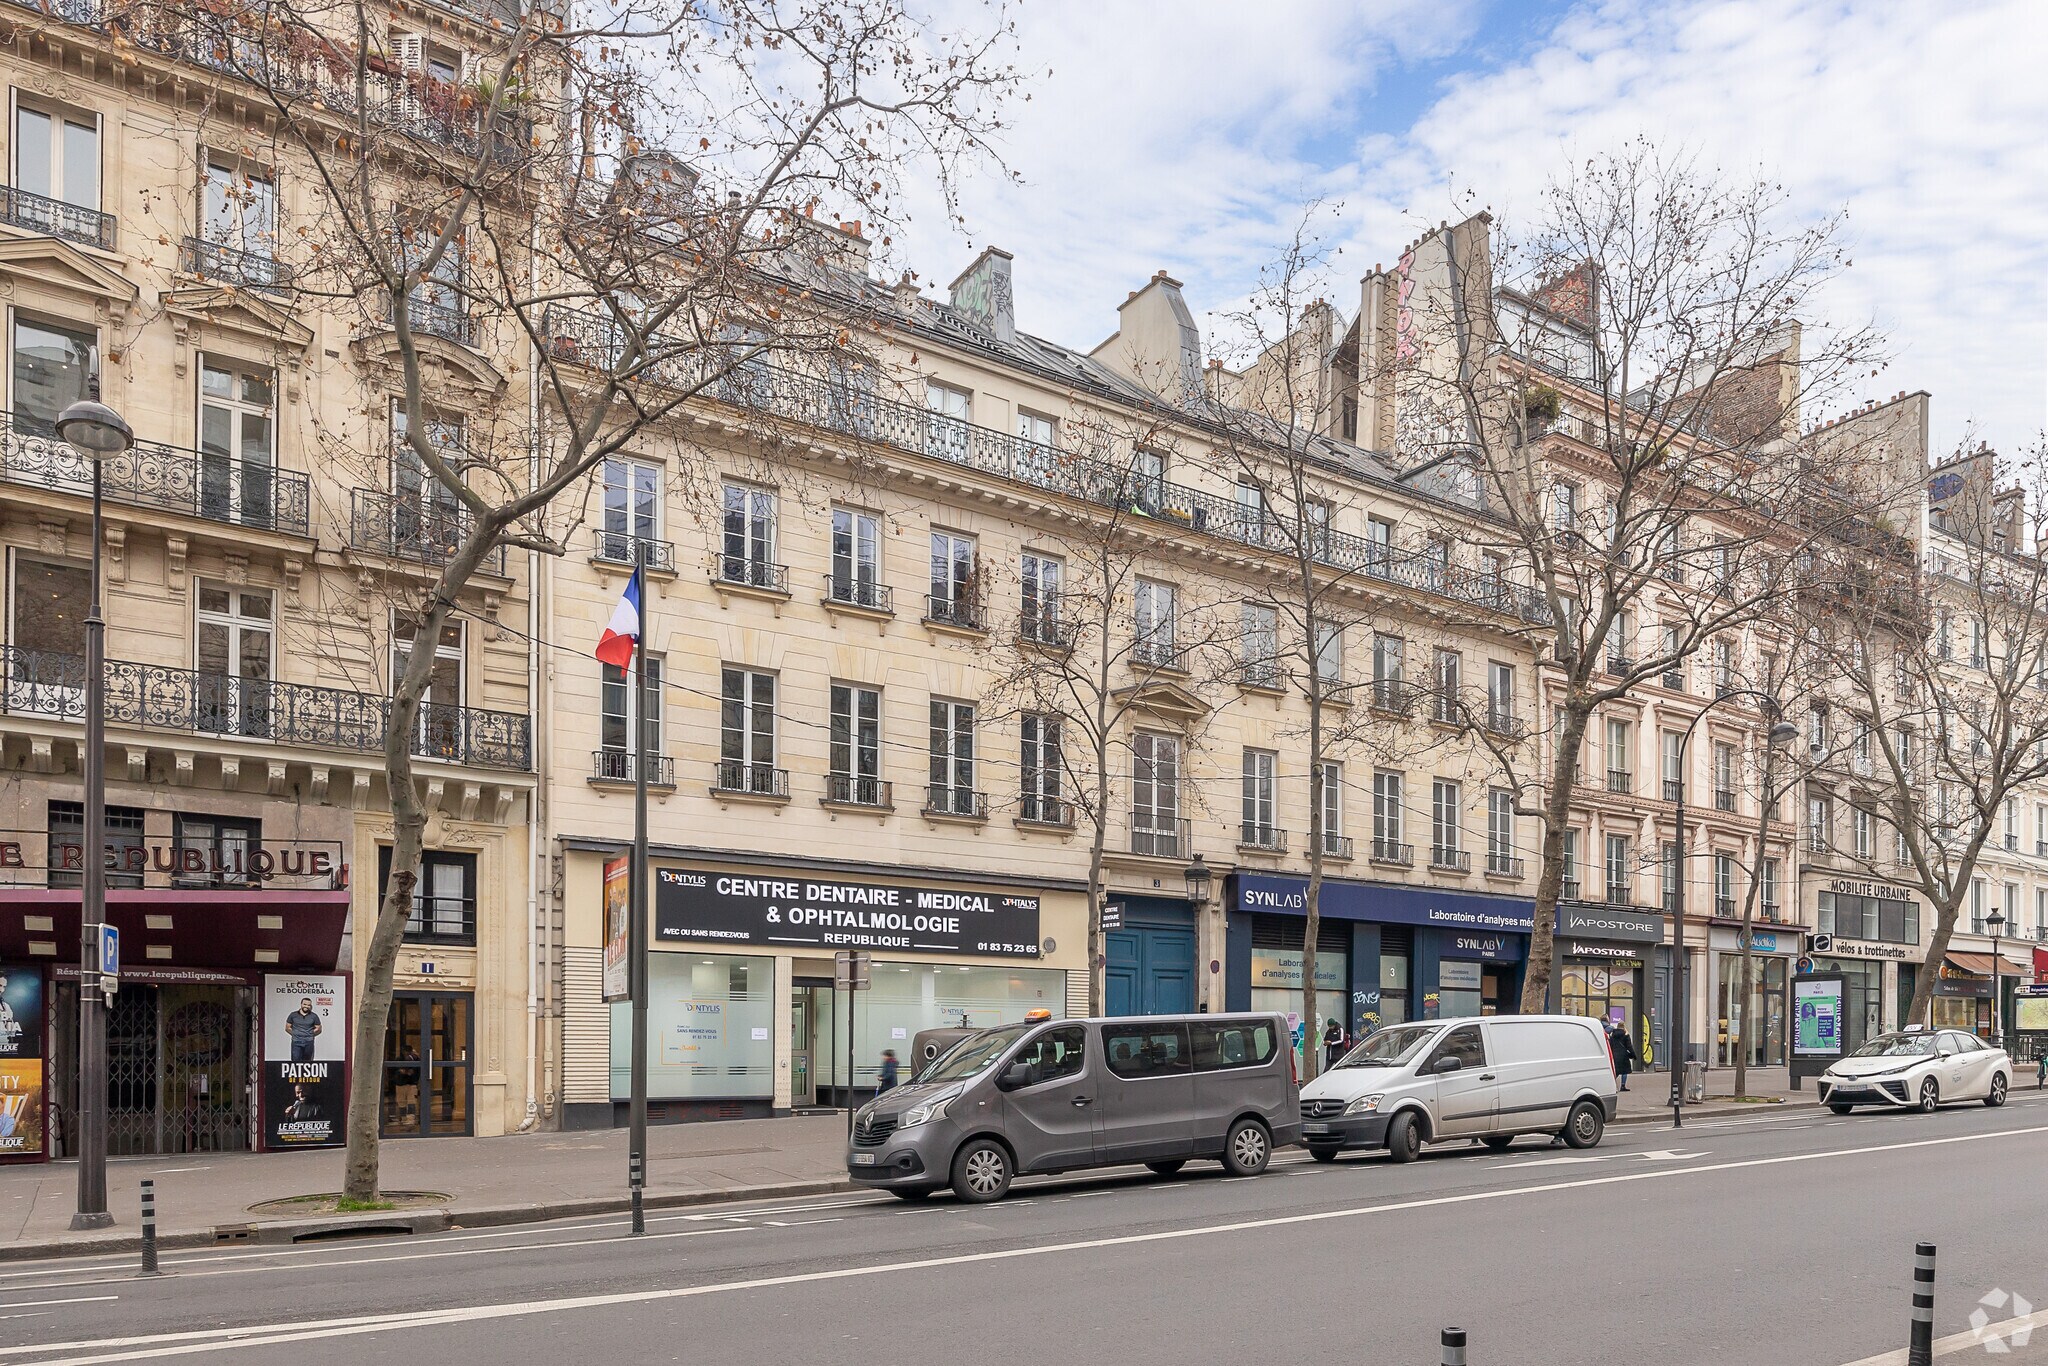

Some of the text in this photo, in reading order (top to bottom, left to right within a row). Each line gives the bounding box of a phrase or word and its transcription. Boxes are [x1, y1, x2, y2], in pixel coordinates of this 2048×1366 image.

[661, 871, 706, 885] DENTYLIS
[716, 877, 800, 900] CENTRE
[806, 884, 900, 906] DENTAIRE
[917, 892, 995, 913] MEDICAL
[1831, 880, 1911, 901] MOBILITÉ URBAINE
[1245, 890, 1302, 908] SYNLAB
[766, 906, 960, 934] & OPHTALMOLOGIE
[1429, 909, 1476, 923] Laboratoire
[1477, 913, 1518, 928] d'analyses
[1569, 912, 1654, 932] VAPOSTORE
[663, 927, 680, 936] AVEC
[691, 929, 708, 937] SANS
[709, 930, 750, 939] RENDEZ-VOUS
[824, 933, 910, 947] REPUBLIQUE
[107, 936, 115, 965] P
[977, 943, 1037, 953] 01 83 75 23 65
[1457, 937, 1495, 950] SYNLAB
[1572, 941, 1637, 957] VAPOSTORE
[1836, 942, 1855, 954] vélos
[1857, 946, 1863, 955] &
[1864, 945, 1906, 958] trottinettes
[1278, 958, 1319, 968] Laborae
[1262, 969, 1300, 979] d'analyses
[1389, 967, 1395, 977] 3
[297, 981, 324, 989] COMTE
[322, 1008, 329, 1017] 3
[281, 1063, 328, 1078] PATSON
